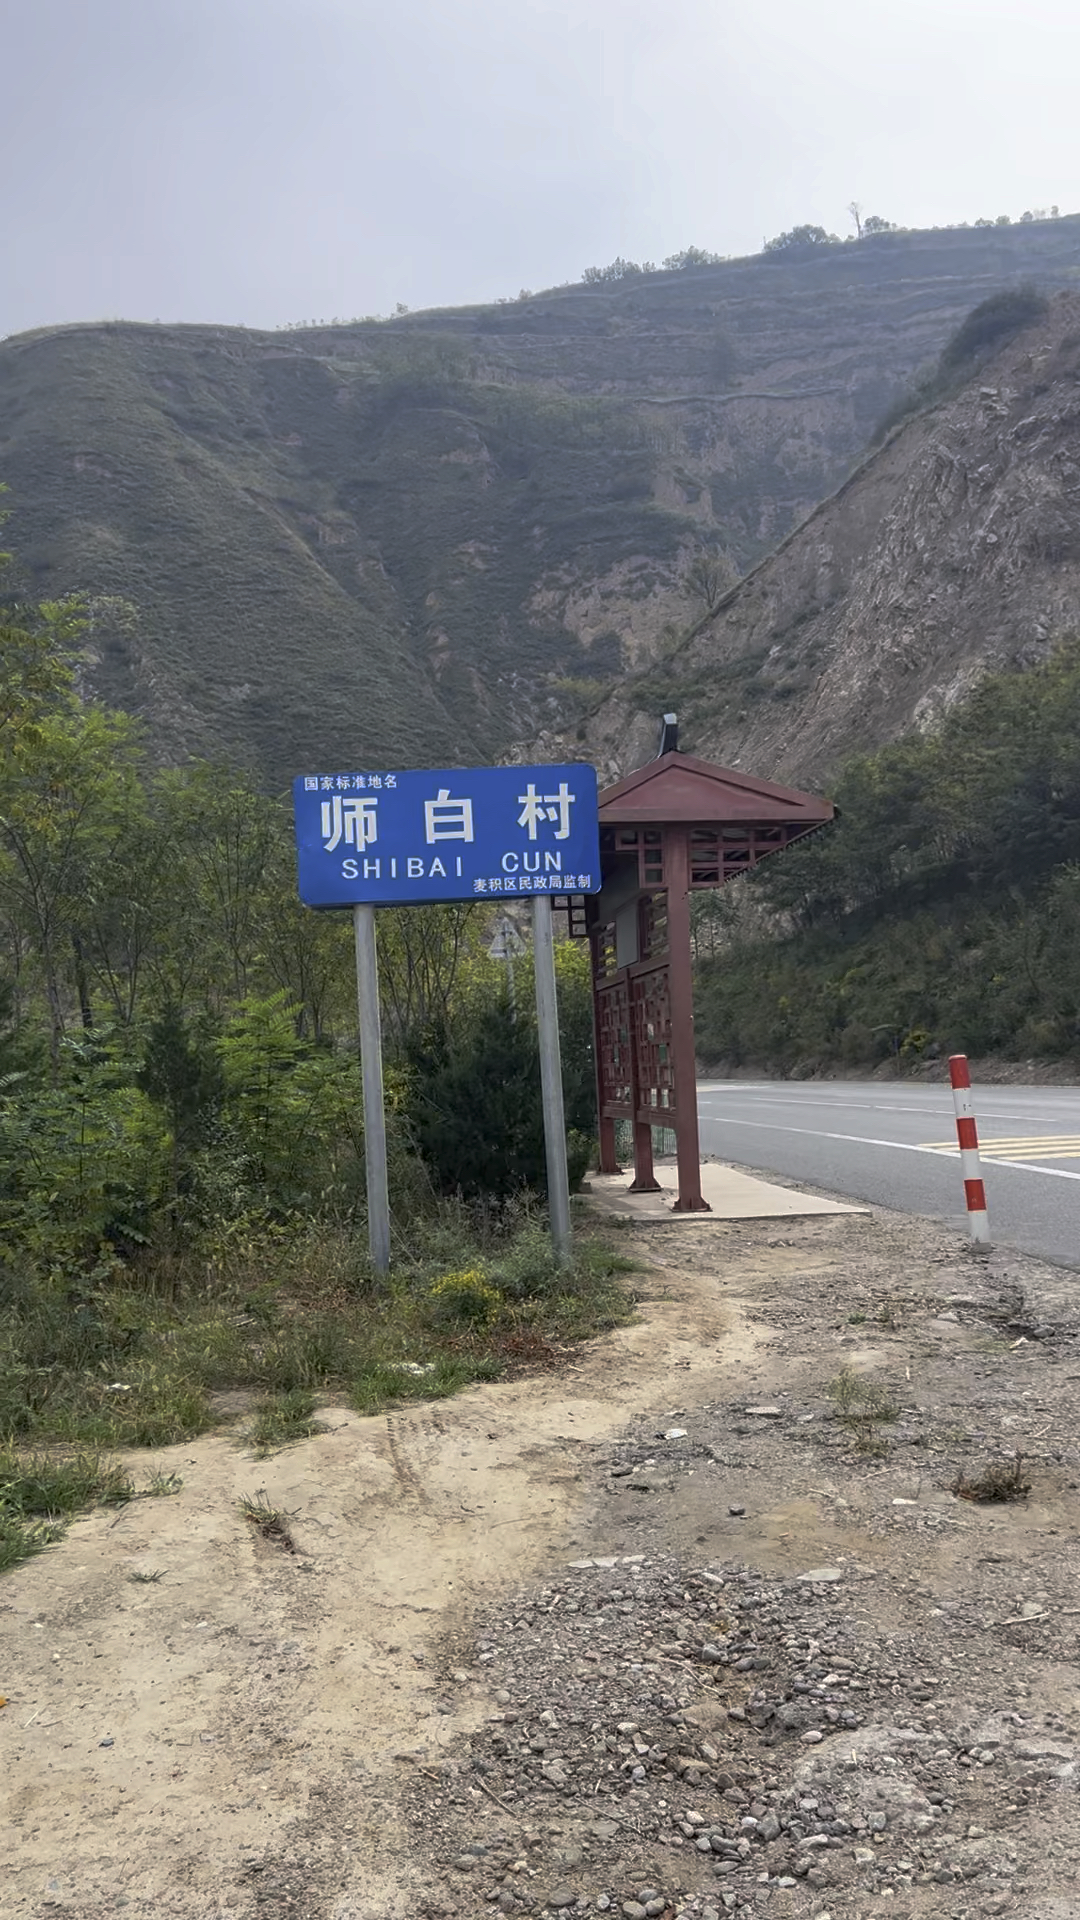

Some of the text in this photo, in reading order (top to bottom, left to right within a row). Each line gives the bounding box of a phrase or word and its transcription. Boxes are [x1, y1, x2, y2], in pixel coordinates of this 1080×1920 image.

[304, 774, 397, 791] 国家标准地名
[321, 783, 575, 852] 师白村
[341, 851, 562, 879] SHIBAI CUN
[473, 874, 591, 893] 麦积区民政局监制
